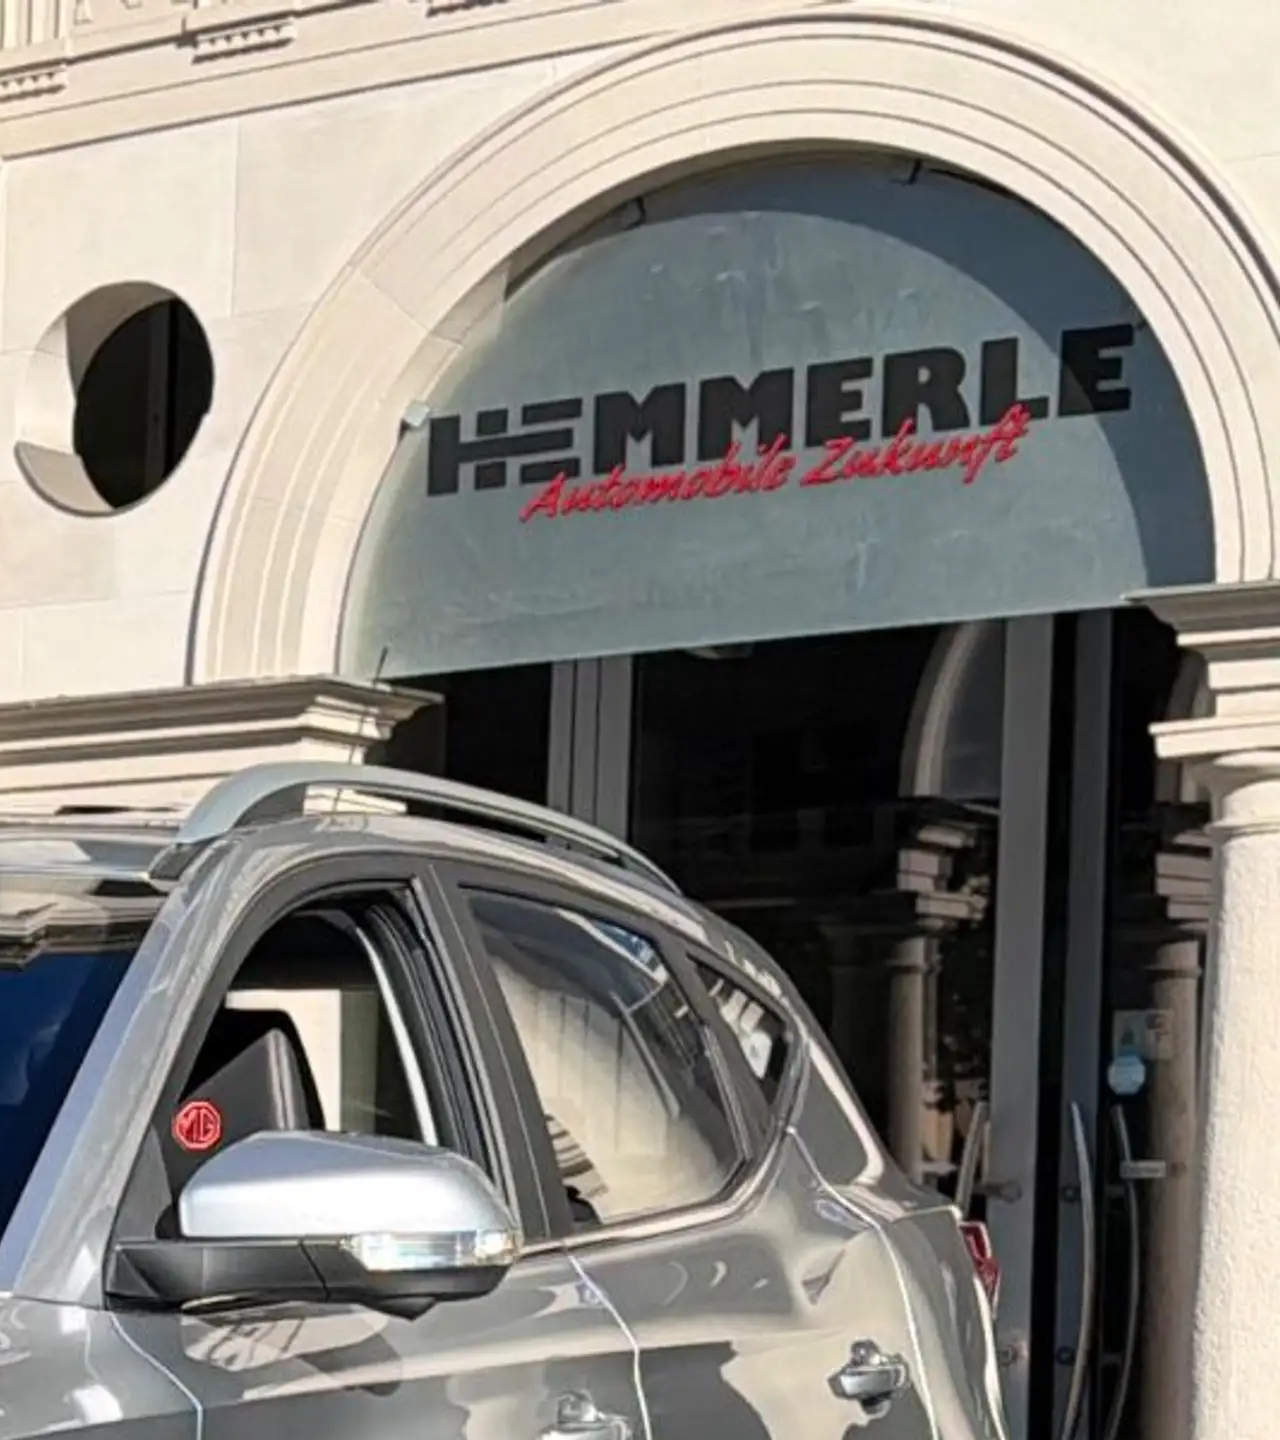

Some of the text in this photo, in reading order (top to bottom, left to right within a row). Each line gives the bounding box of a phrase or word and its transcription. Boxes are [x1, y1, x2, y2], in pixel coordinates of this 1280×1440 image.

[428, 324, 1135, 497] HEMMERLE
[519, 402, 1031, 525] Automobile Zukunft
[177, 1106, 218, 1145] MG
